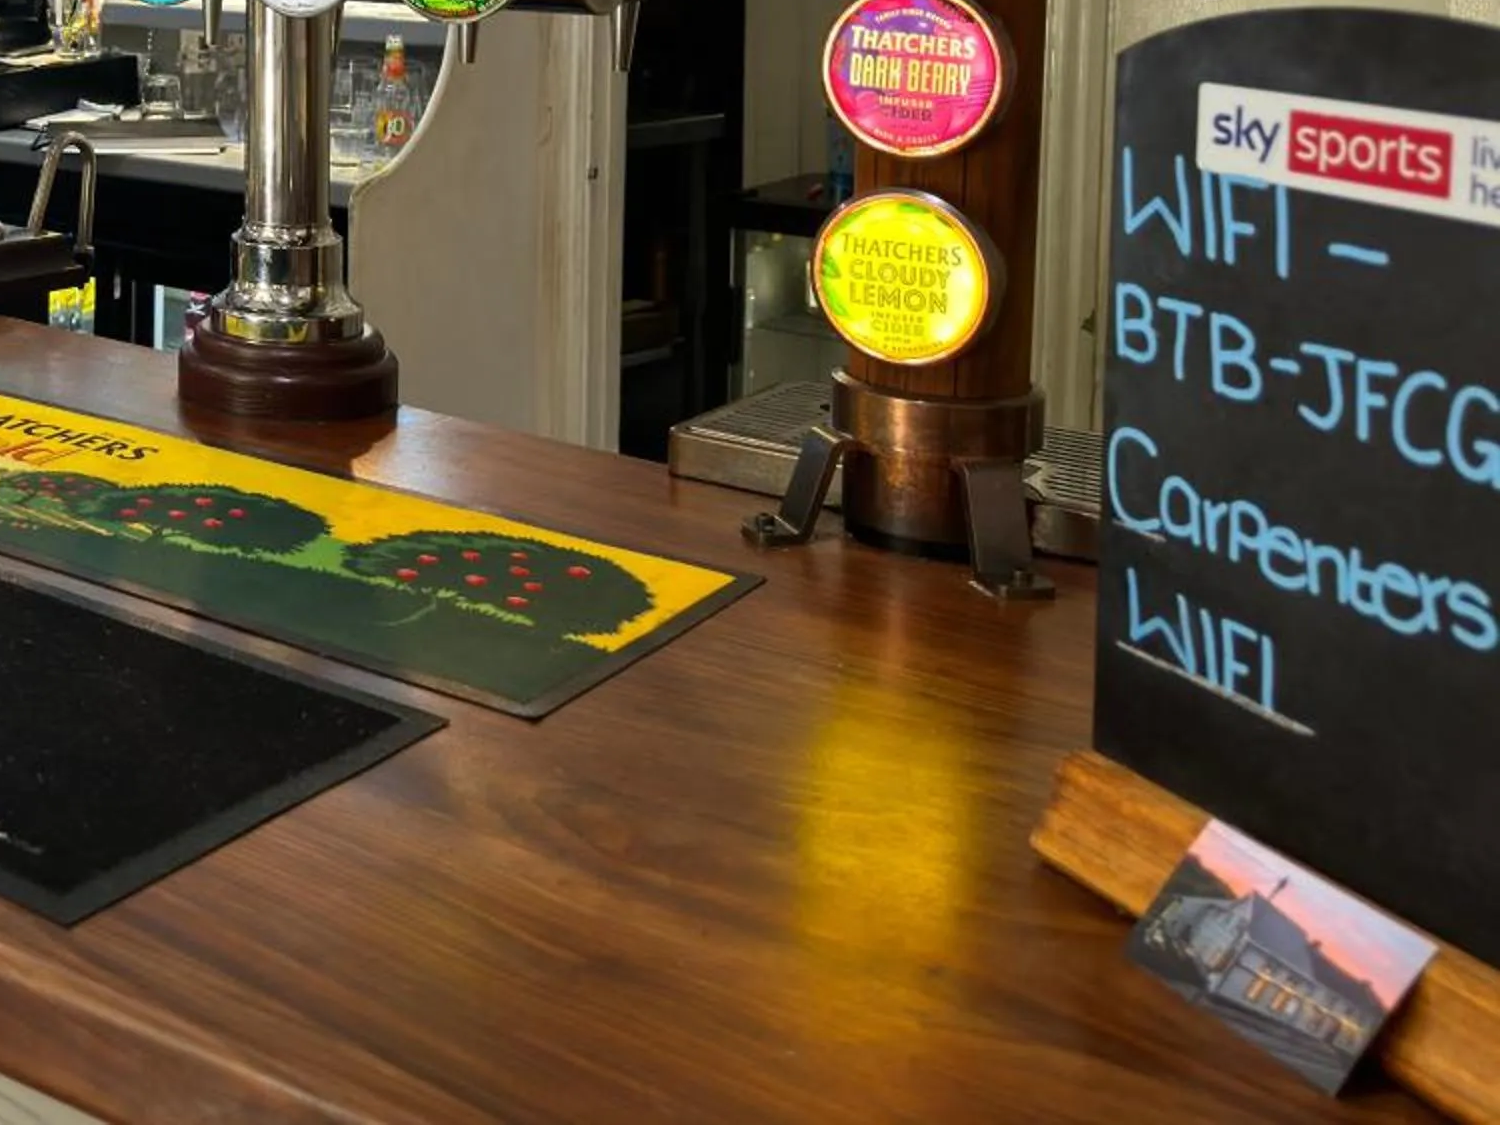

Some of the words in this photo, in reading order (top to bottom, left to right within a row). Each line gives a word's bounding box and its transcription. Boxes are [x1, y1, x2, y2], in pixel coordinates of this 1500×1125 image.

[851, 25, 977, 60] THATCHERS
[850, 52, 900, 90] DARK
[907, 58, 972, 96] BERRY
[1212, 105, 1281, 163] sky
[1294, 125, 1443, 182] sports
[1471, 135, 1500, 170] liv
[1123, 145, 1290, 279] WIFI
[842, 232, 962, 266] THATCHERS
[850, 259, 951, 289] CLOUDY
[849, 283, 948, 315] LEMON
[1126, 567, 1276, 715] WIFI
